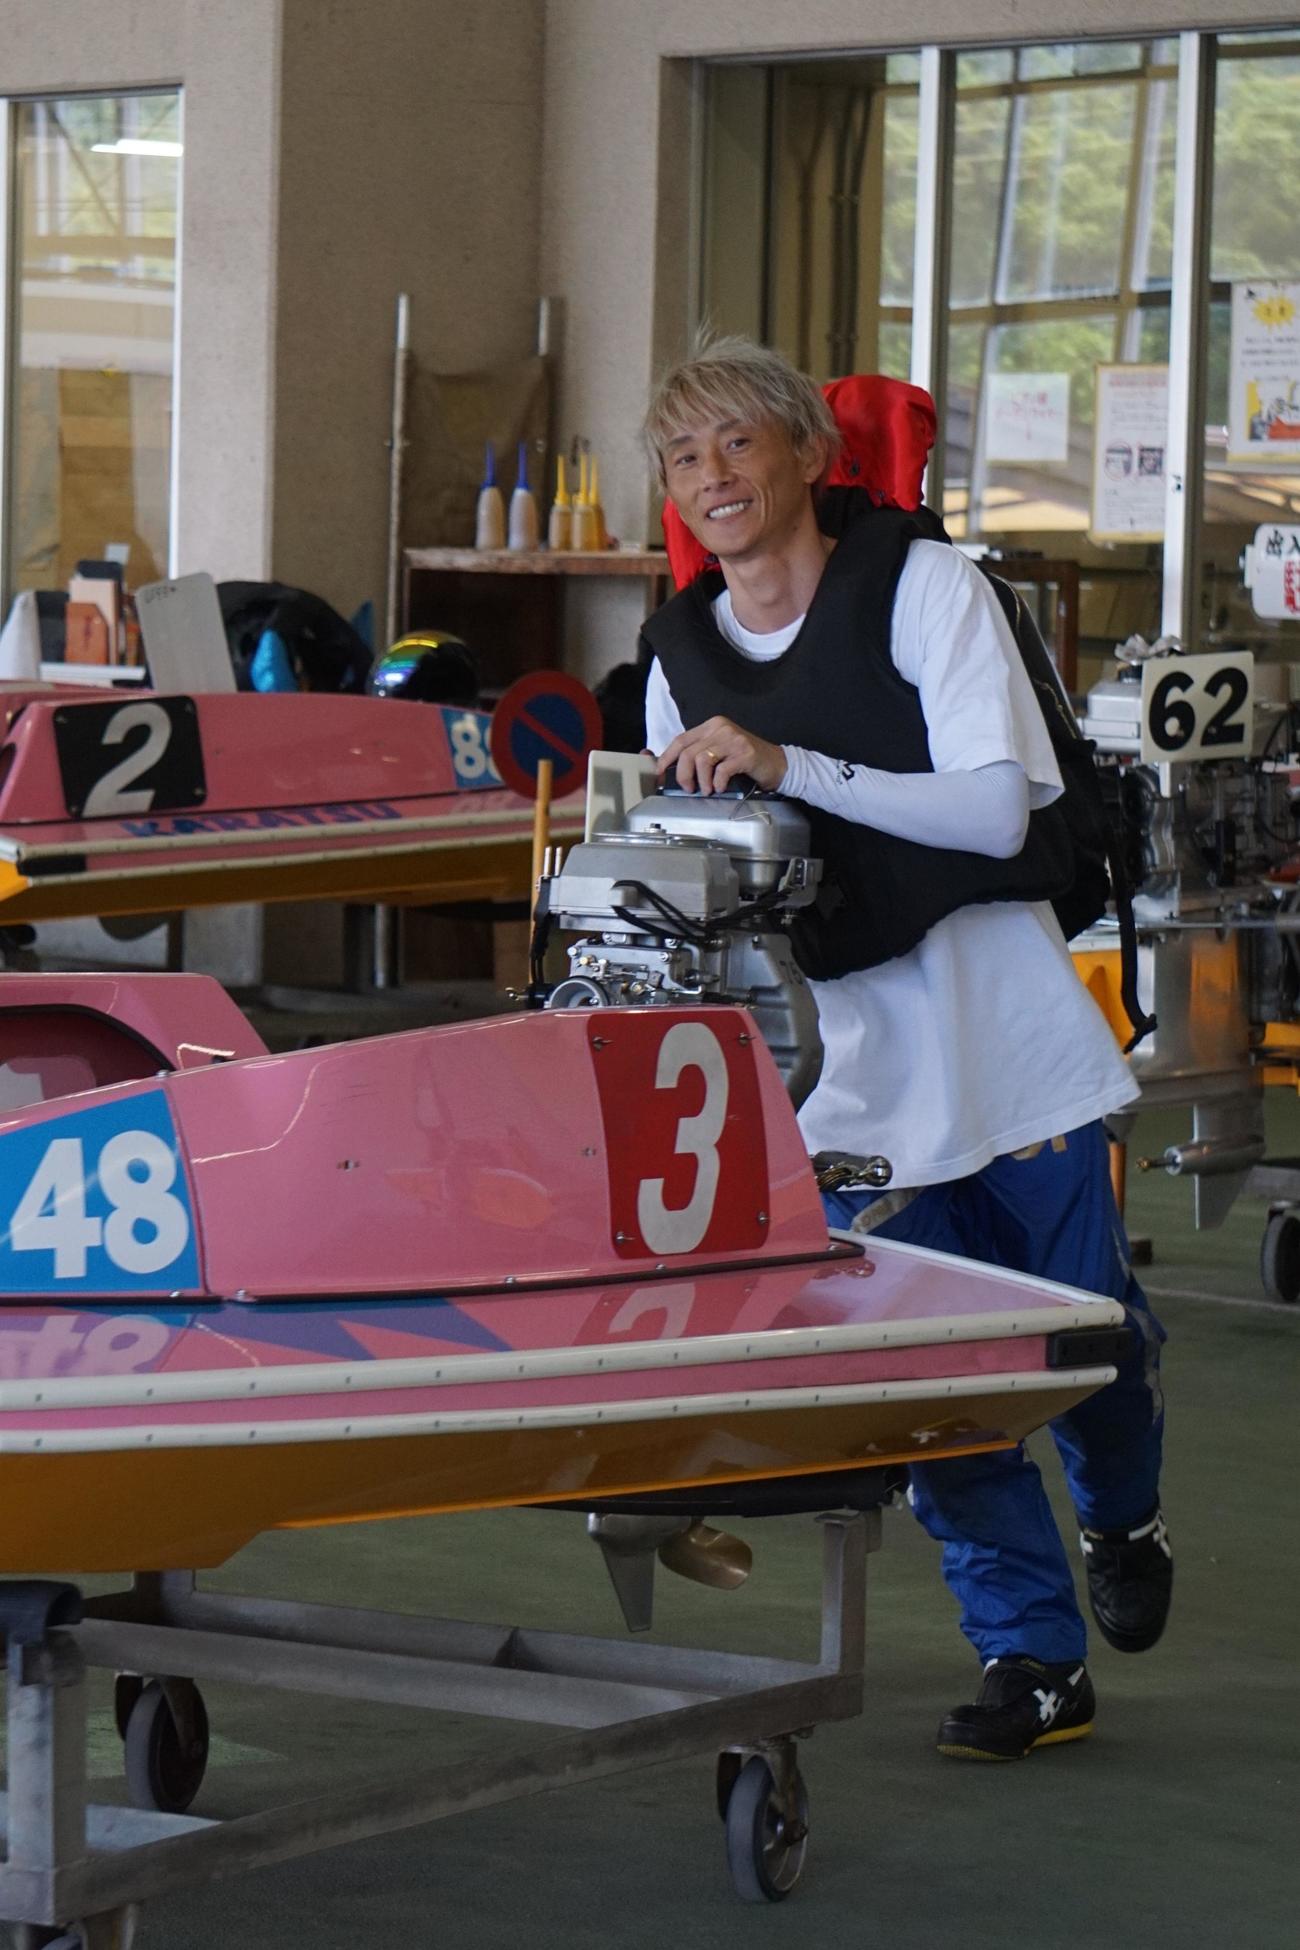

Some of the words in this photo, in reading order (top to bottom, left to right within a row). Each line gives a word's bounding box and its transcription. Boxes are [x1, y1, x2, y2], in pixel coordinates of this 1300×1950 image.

[451, 715, 502, 781] 8
[1149, 667, 1248, 751] 62
[82, 702, 172, 818] 2
[121, 802, 403, 838] KARATSU
[637, 1022, 729, 1255] 3
[10, 1131, 188, 1279] 48
